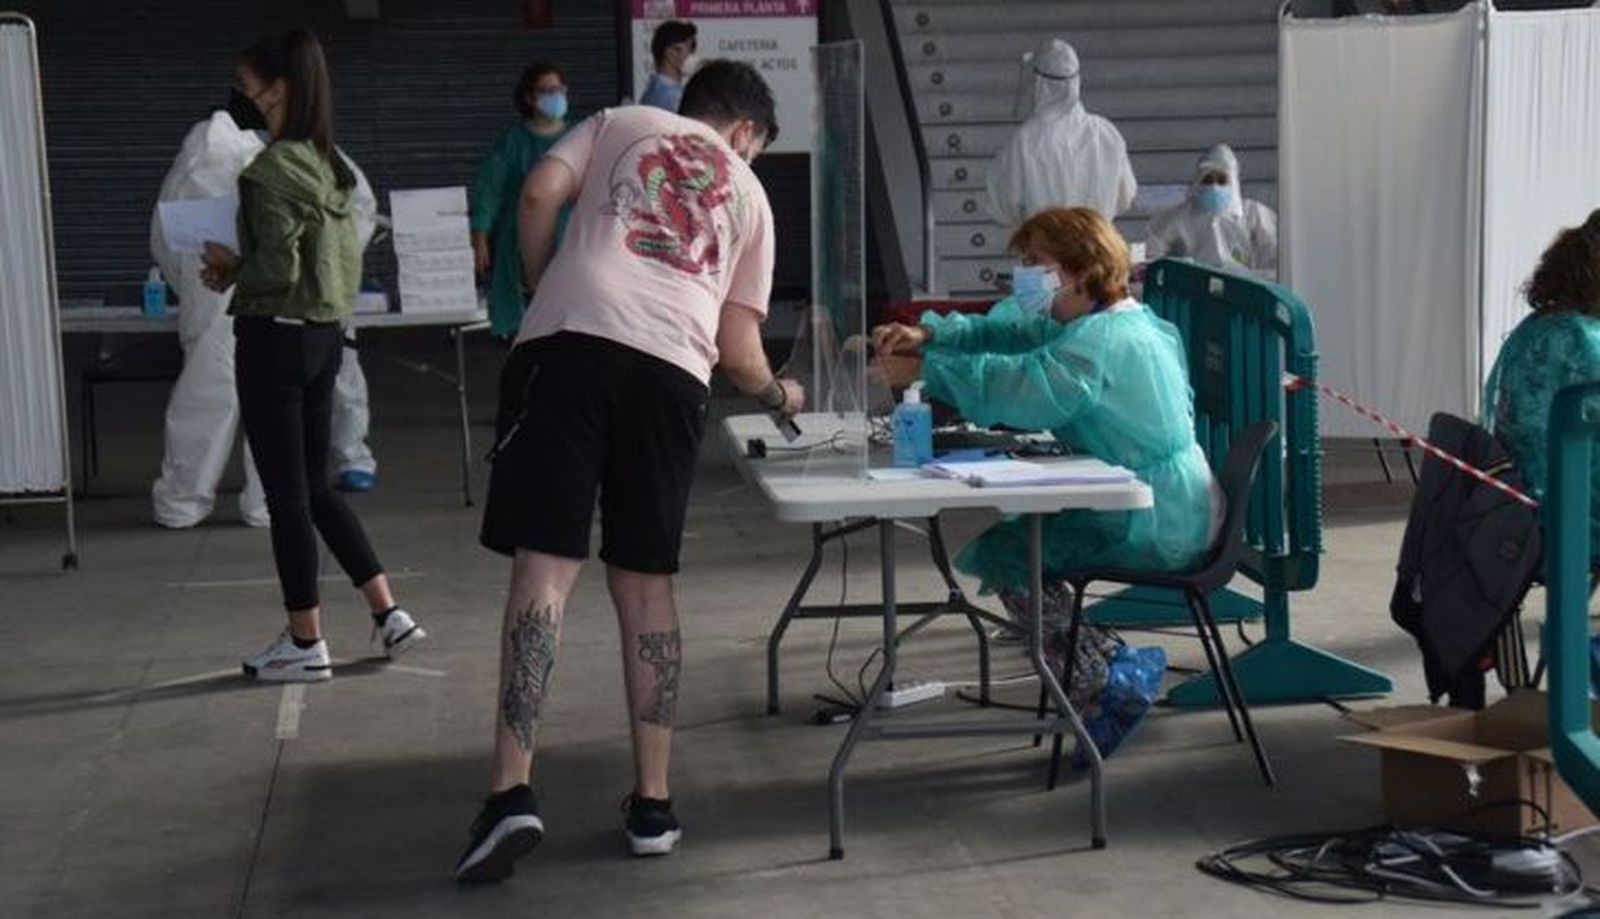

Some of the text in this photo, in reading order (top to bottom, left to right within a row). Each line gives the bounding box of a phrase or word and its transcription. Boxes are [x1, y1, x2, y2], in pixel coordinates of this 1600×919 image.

[690, 1, 787, 13] PRIMERA PLANTA
[761, 58, 798, 70] ACTOS
